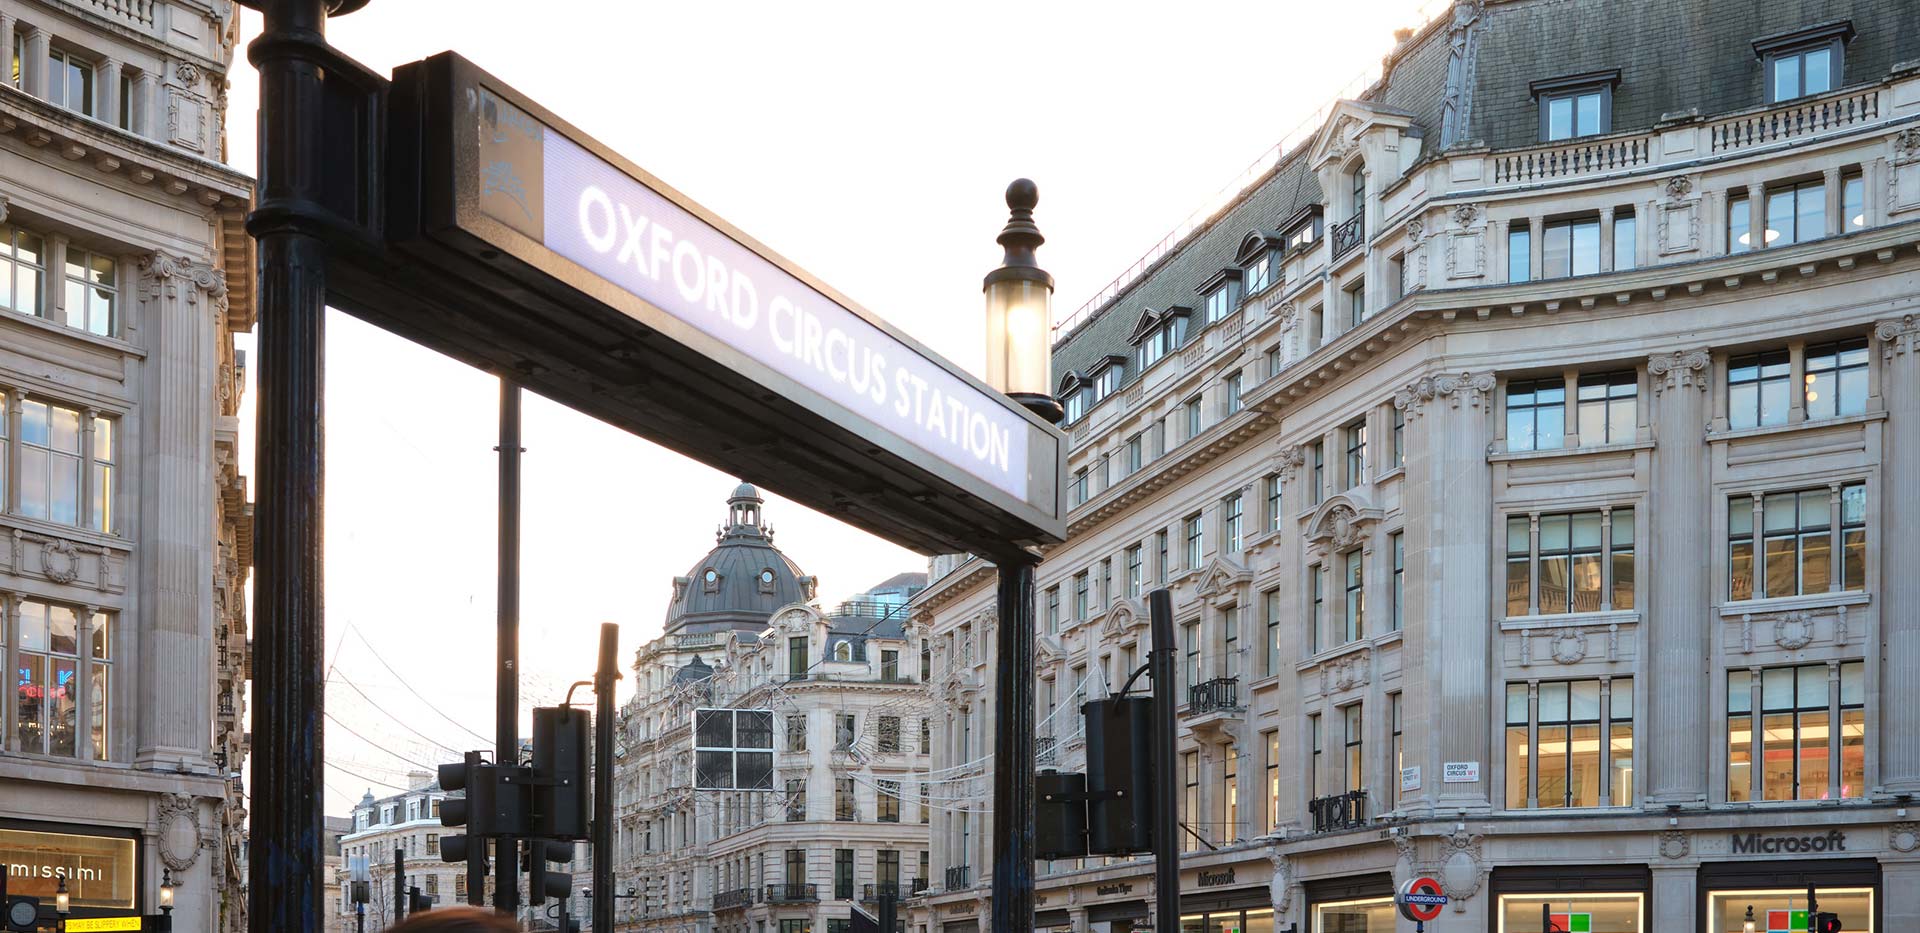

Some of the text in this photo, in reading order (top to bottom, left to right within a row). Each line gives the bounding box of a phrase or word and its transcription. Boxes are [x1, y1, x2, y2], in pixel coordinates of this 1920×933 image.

[578, 185, 1009, 472] OXFORD CIRCUS STATION
[1731, 830, 1846, 854] Microsoft
[1197, 867, 1236, 887] Microsoft
[1405, 895, 1447, 903] UNDERGROUND
